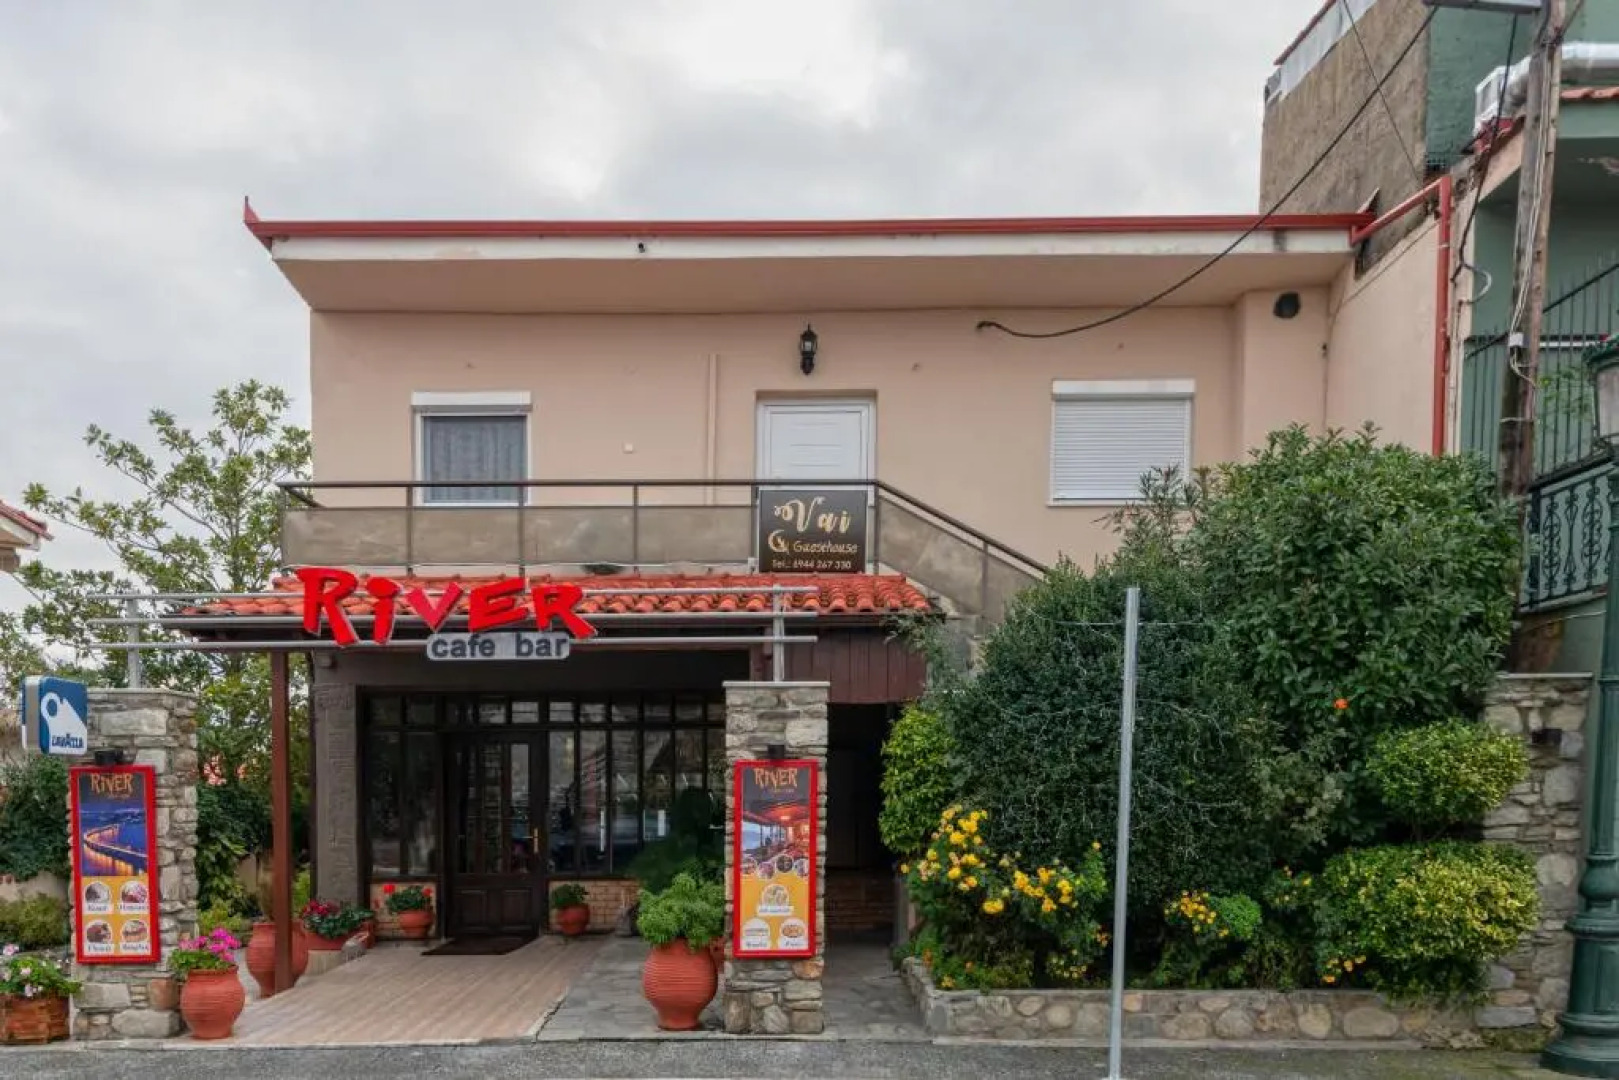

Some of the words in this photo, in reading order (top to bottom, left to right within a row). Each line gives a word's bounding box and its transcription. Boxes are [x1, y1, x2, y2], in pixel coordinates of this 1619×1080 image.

[774, 496, 851, 534] Vai
[793, 541, 858, 553] Guesthouse
[793, 560, 815, 569] 6944
[816, 560, 832, 569] 267
[834, 560, 851, 569] 330
[431, 634, 494, 658] cafe
[516, 634, 567, 658] bar
